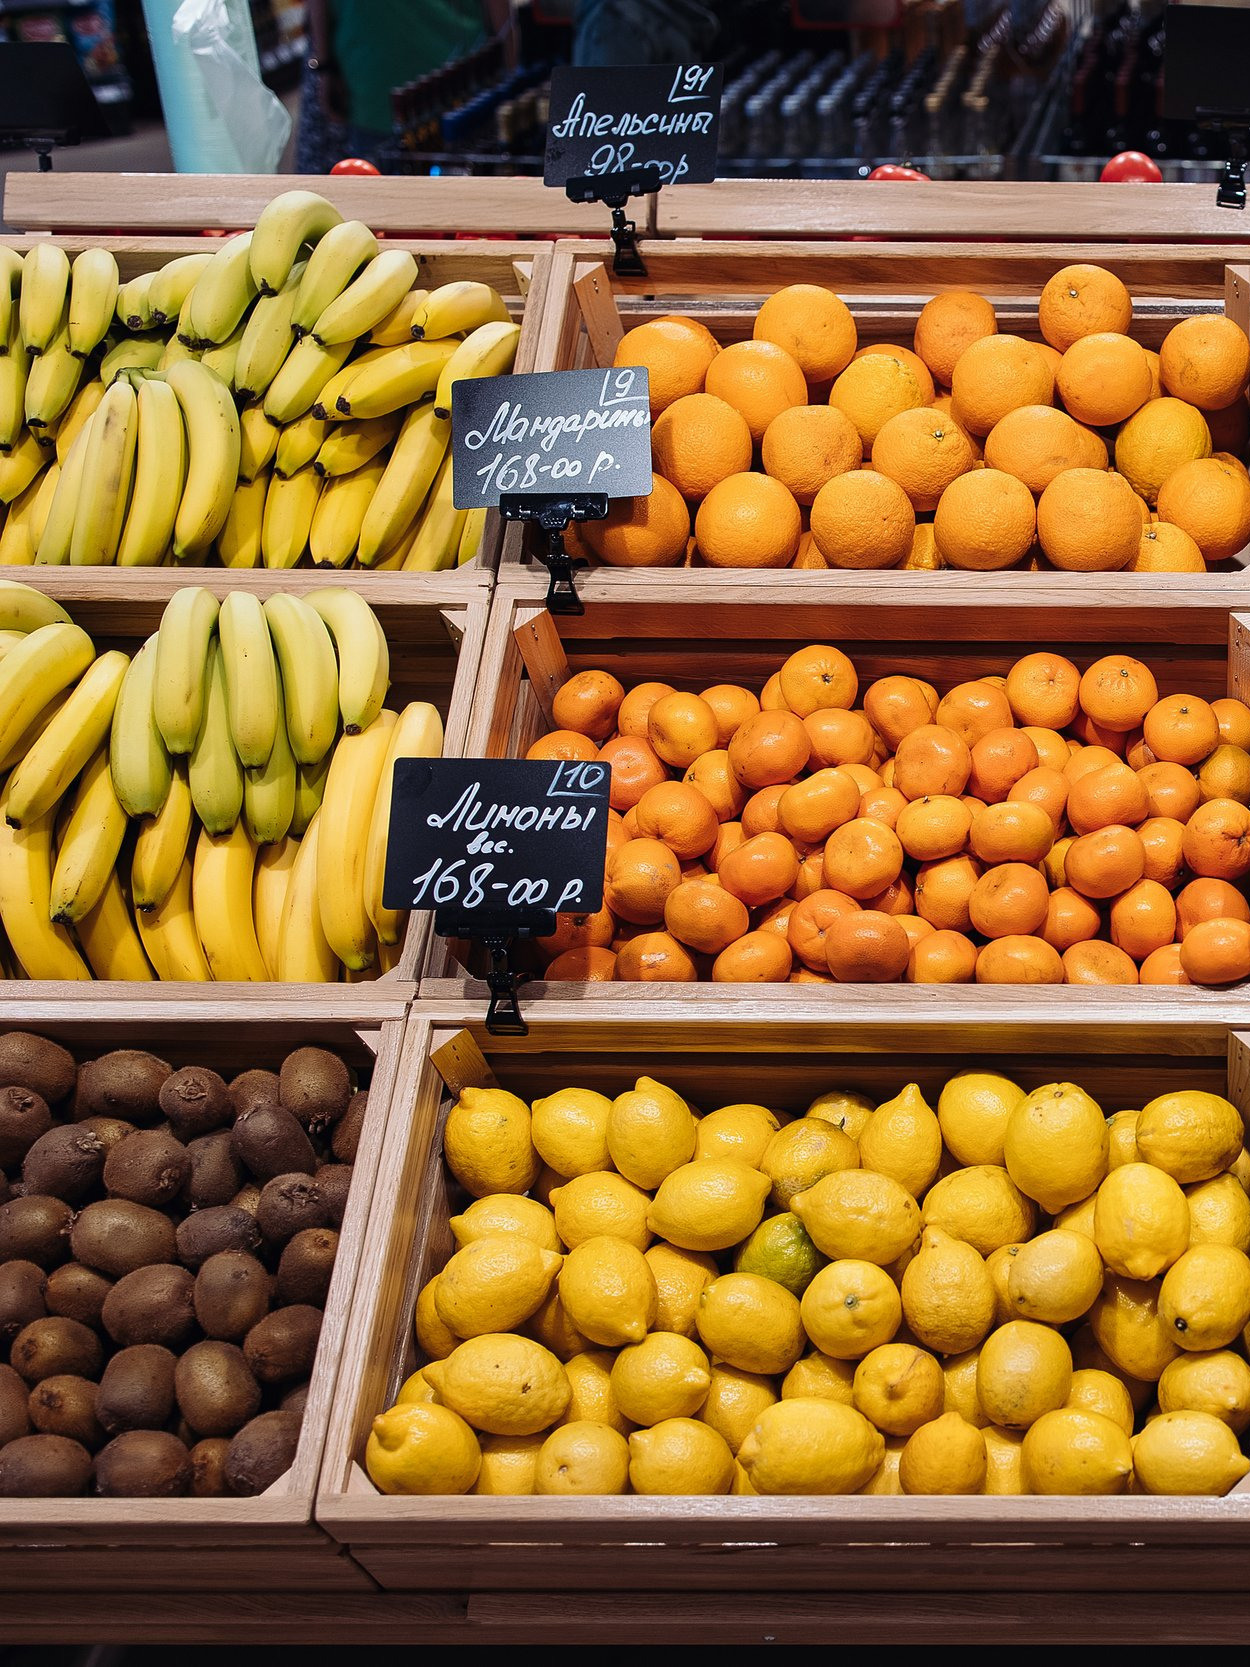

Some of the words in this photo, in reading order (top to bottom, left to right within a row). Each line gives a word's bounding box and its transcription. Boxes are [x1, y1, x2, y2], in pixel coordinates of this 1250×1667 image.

[683, 65, 714, 92] 91
[552, 92, 713, 137] Апельсины
[476, 453, 582, 495] 168-00
[564, 761, 605, 790] 10
[426, 782, 597, 831] Лимоны
[466, 831, 514, 855] вес.
[413, 857, 549, 908] 168-00
